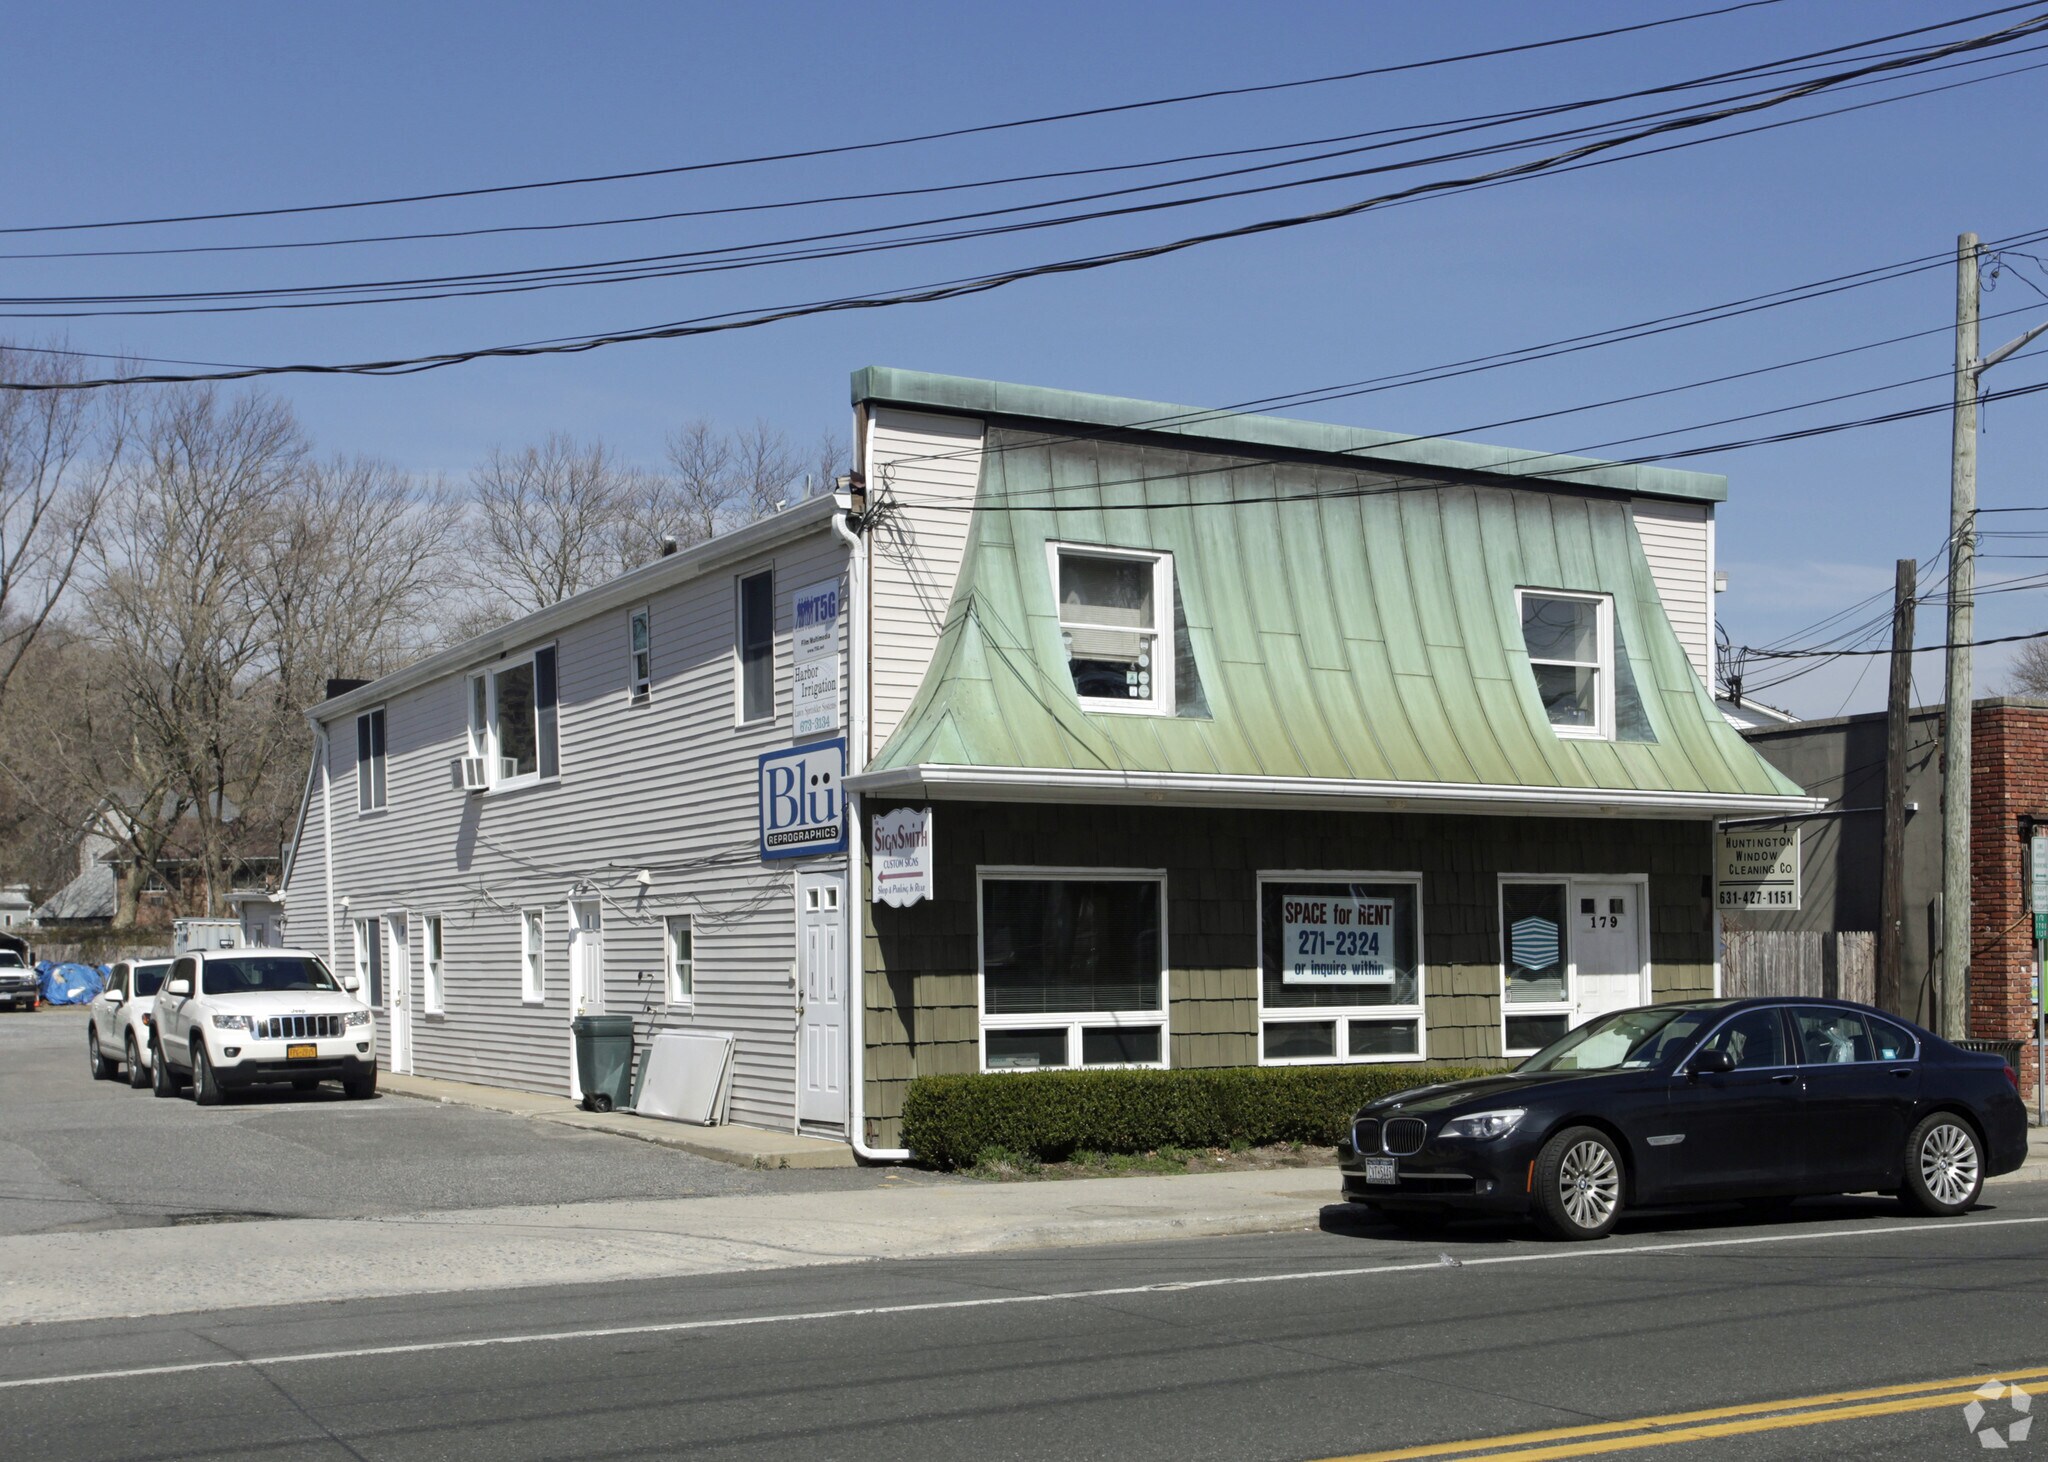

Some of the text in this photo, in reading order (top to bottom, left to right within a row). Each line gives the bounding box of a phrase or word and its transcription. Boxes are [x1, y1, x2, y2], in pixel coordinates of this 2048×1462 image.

[814, 592, 836, 621] T5G
[795, 665, 819, 682] Harbor
[801, 678, 836, 699] Irrigation
[766, 759, 838, 830] Blü
[768, 827, 837, 845] REPROGRAPHICS
[1726, 837, 1793, 848] HUNTINGTON
[883, 857, 919, 870] CUSTOM SIGNS
[1736, 851, 1778, 862] WINDOW
[1729, 863, 1775, 875] CLEANING
[1720, 891, 1792, 904] 631-427-1151
[1285, 902, 1393, 925] SPACE for RENT
[1591, 916, 1618, 928] 179
[1299, 930, 1379, 956] 271-2324
[1295, 960, 1384, 978] or inquire within
